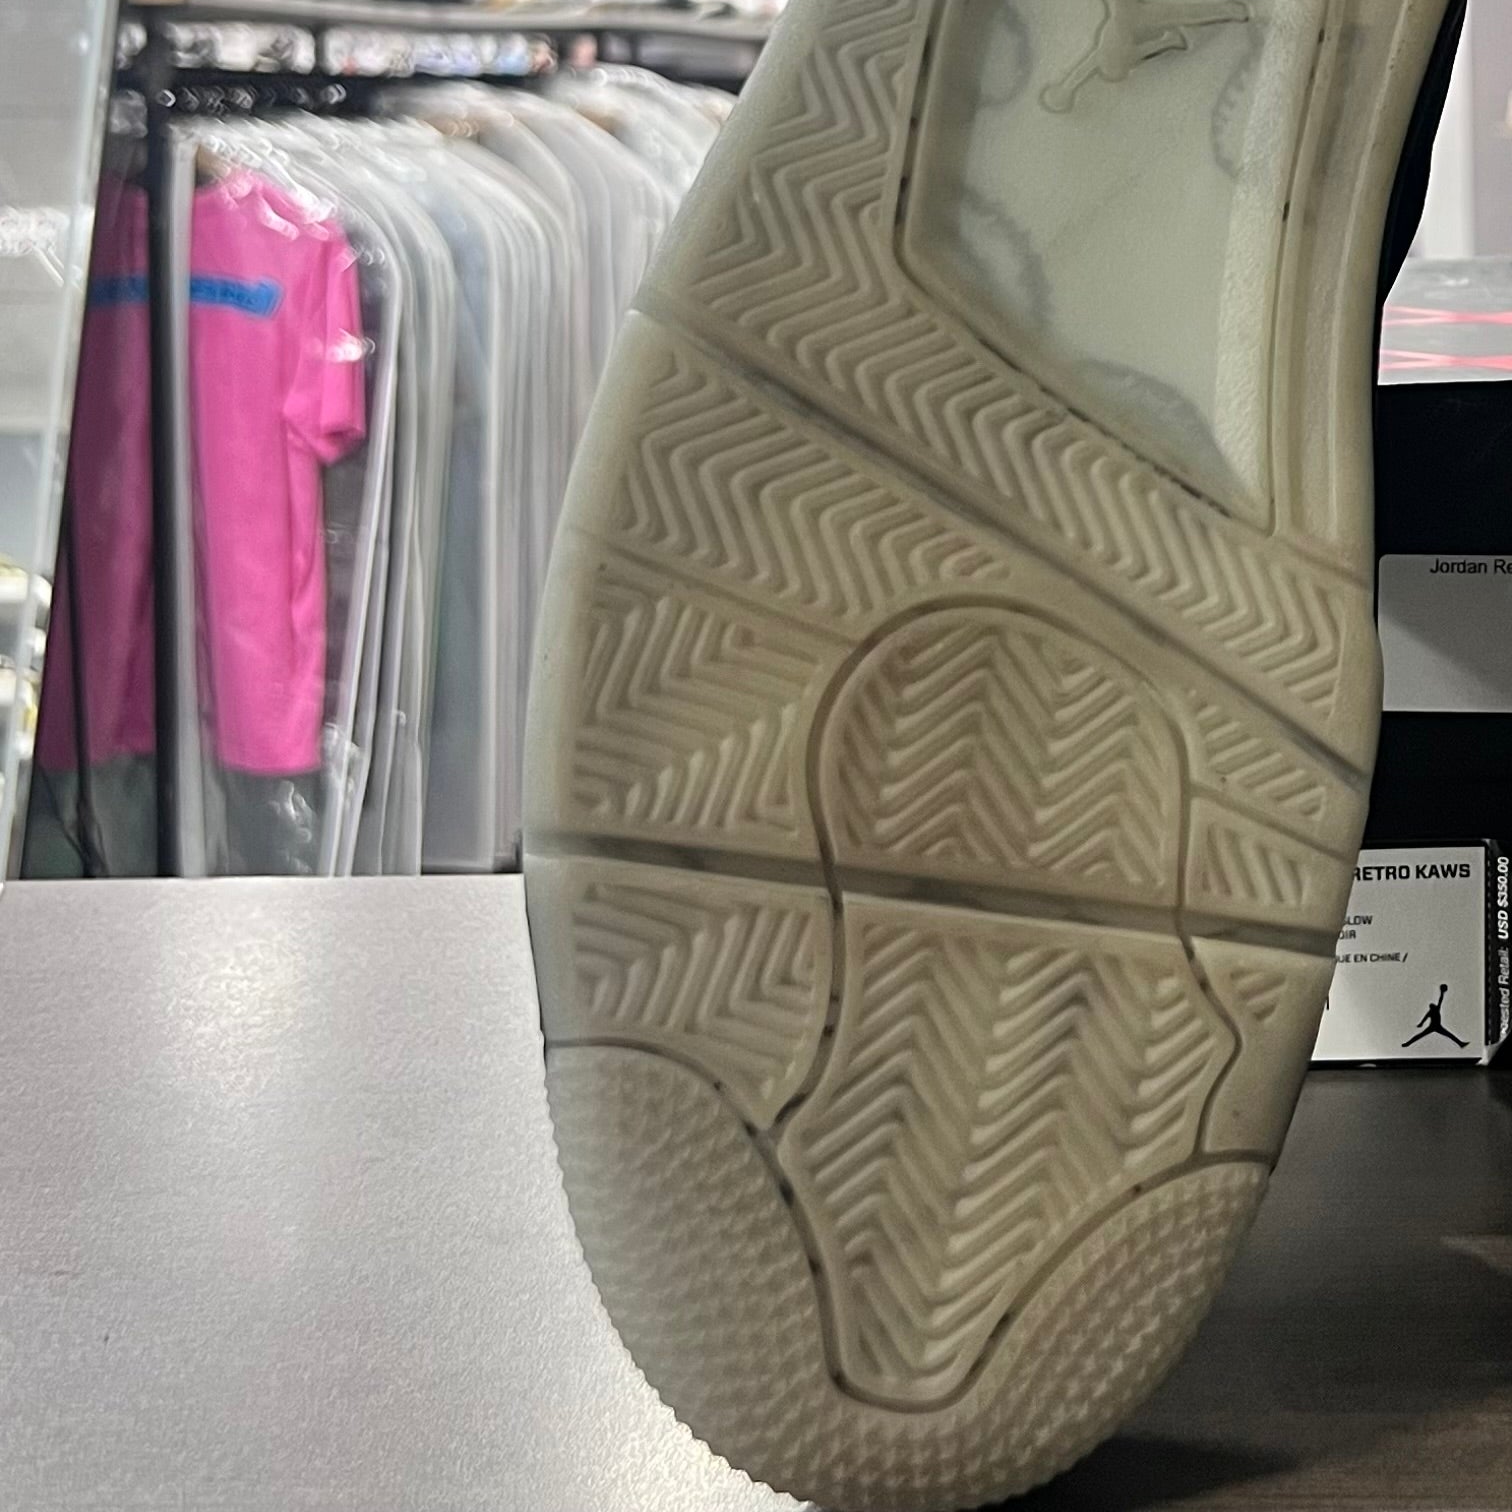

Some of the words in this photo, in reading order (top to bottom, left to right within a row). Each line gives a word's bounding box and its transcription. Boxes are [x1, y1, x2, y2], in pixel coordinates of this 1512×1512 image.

[1430, 559, 1488, 574] Jordan
[1415, 863, 1470, 879] KAWS
[1497, 856, 1509, 908] $350.00
[1345, 915, 1373, 926] LOW
[1497, 909, 1509, 940] USD
